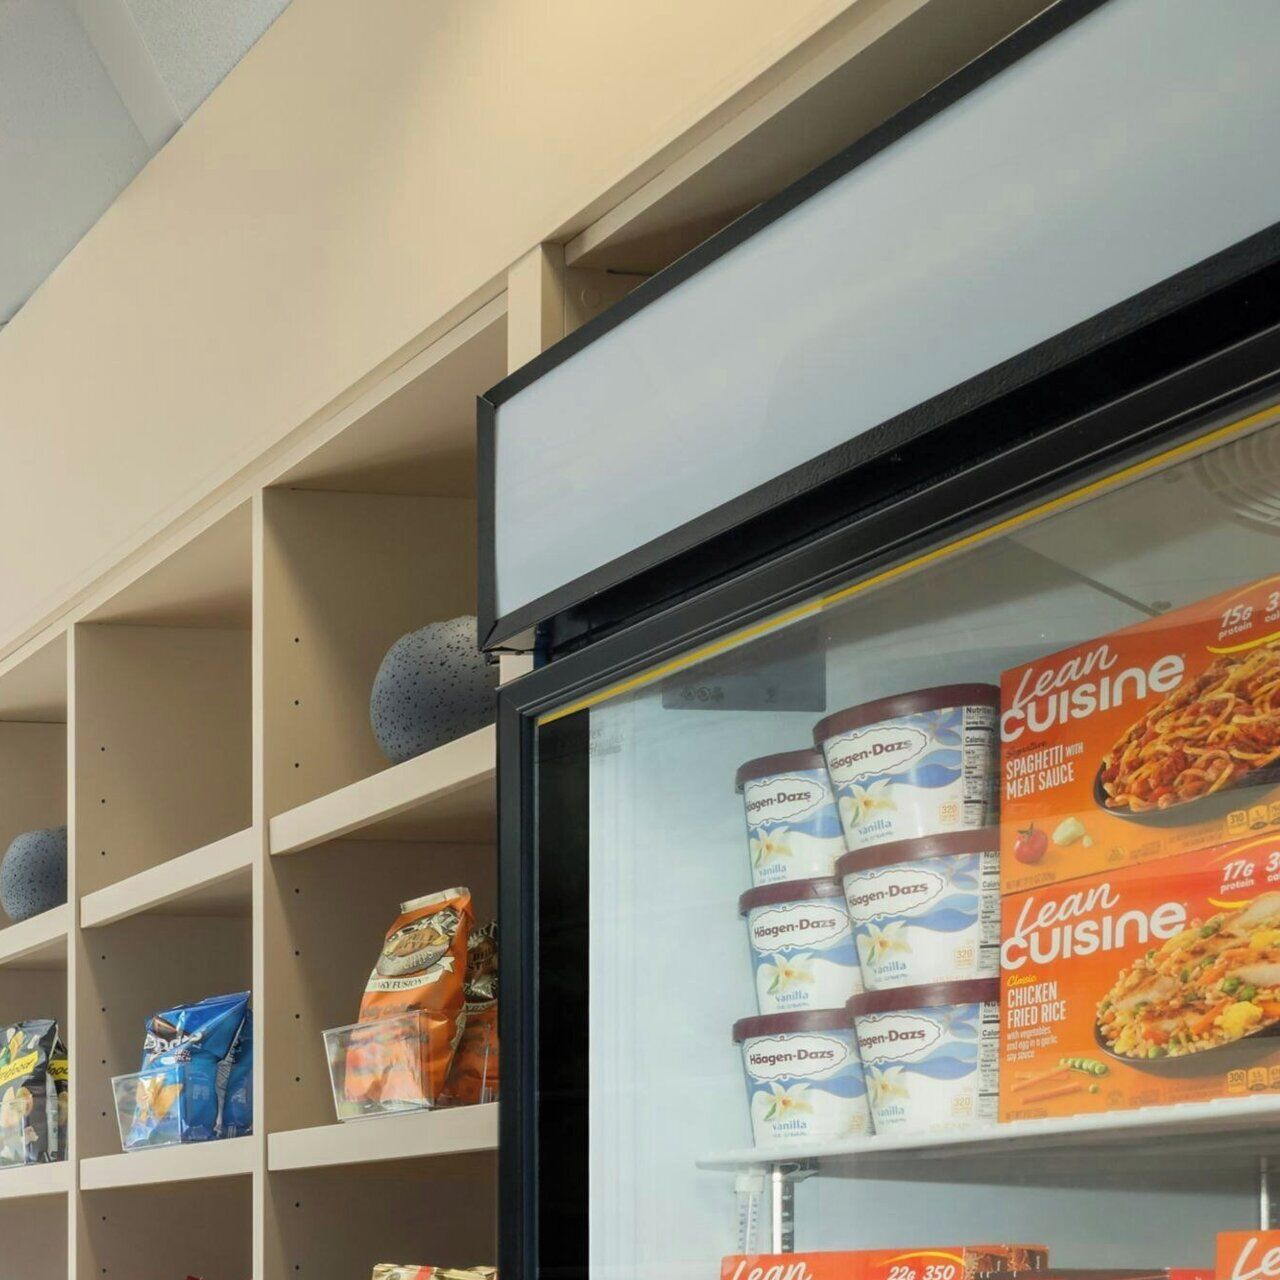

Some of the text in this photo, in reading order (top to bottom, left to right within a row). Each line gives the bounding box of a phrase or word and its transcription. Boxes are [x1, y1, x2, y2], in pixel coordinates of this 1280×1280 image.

[1217, 621, 1252, 641] protein
[1012, 644, 1118, 713] Lean
[1005, 743, 1065, 781] SPAGHETTI
[1006, 761, 1075, 800] MEAT SAUCE
[858, 818, 892, 837] vanilla
[758, 863, 787, 878] vanilla
[1220, 876, 1254, 894] protein
[1014, 883, 1120, 940] Lean
[872, 960, 907, 976] vanilla
[775, 990, 809, 1003] vanilla
[1007, 981, 1058, 1009] CHICKEN
[1007, 1000, 1066, 1030] FRIED RICE
[749, 1049, 835, 1066] Häagen-Dazs
[772, 1118, 807, 1132] vanilla
